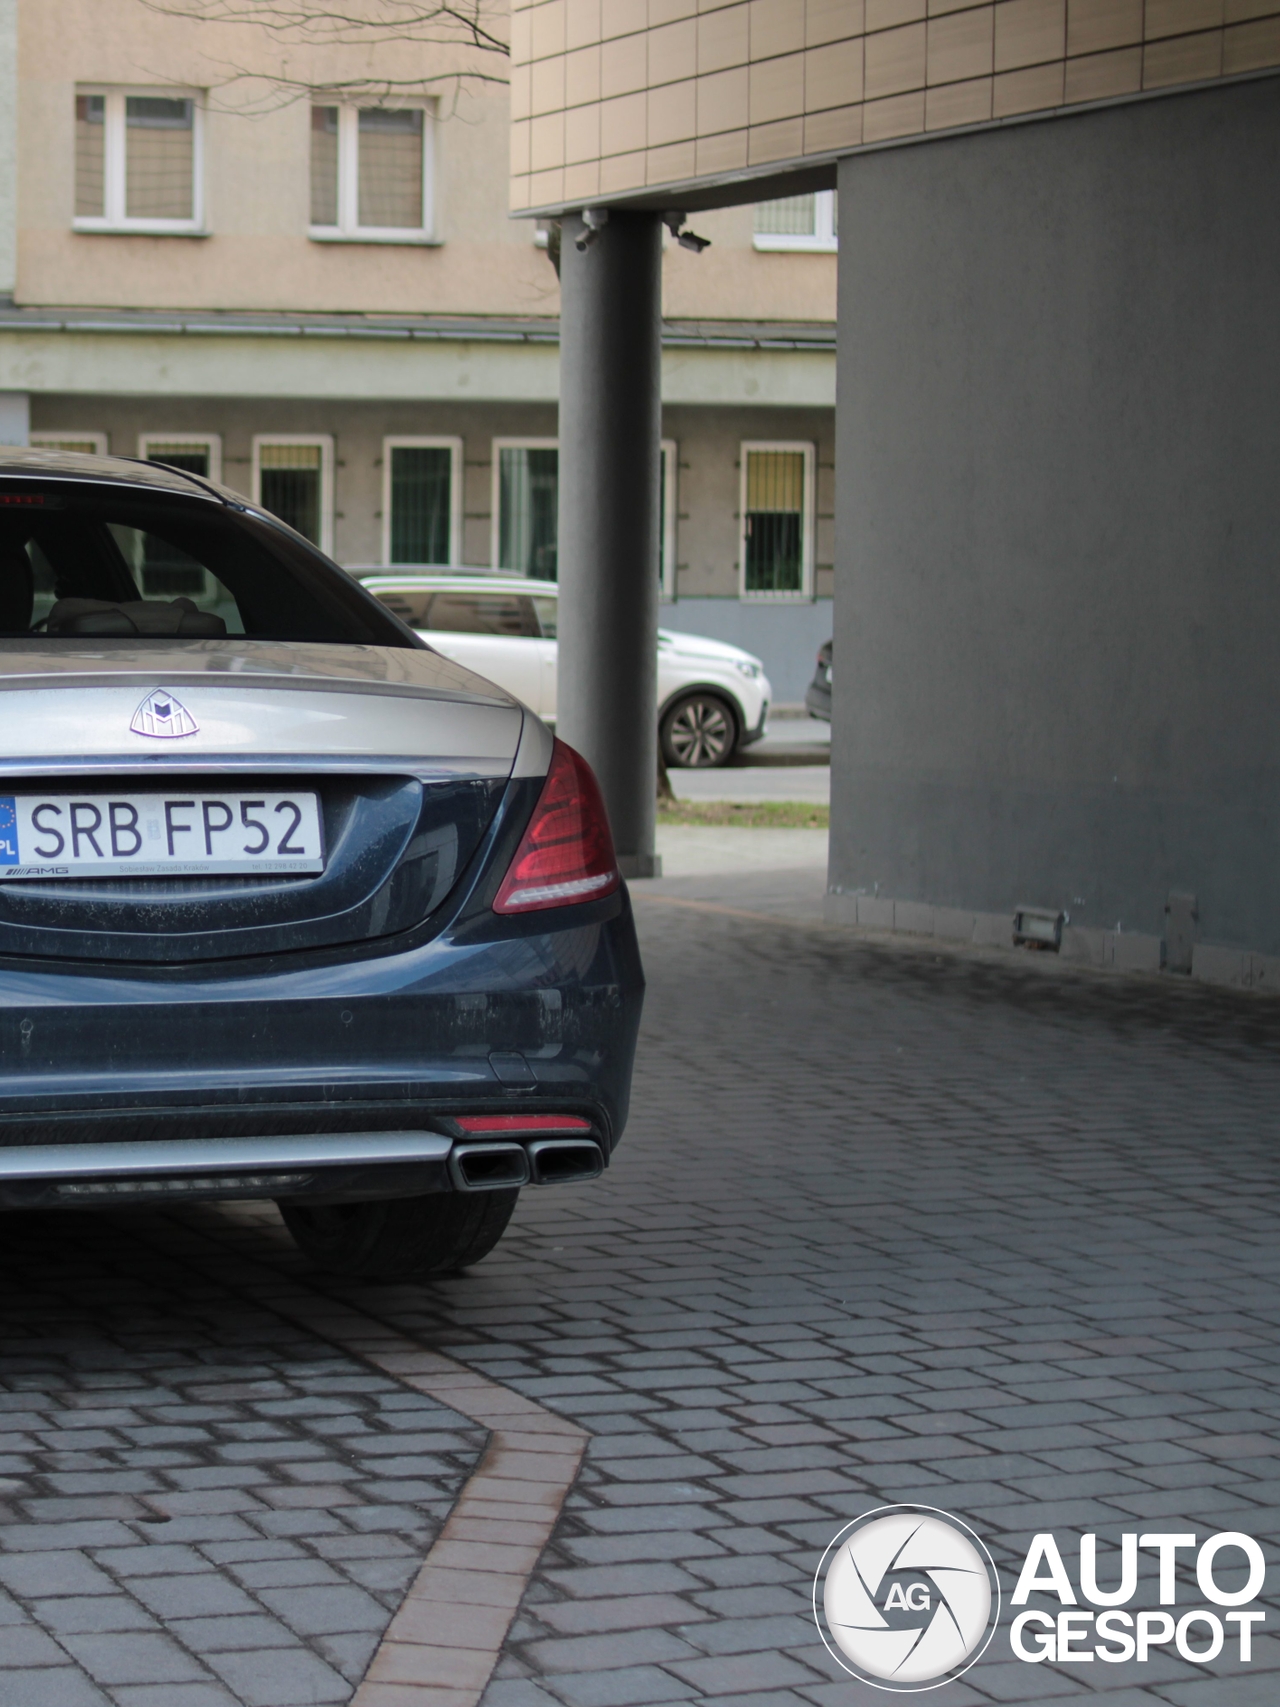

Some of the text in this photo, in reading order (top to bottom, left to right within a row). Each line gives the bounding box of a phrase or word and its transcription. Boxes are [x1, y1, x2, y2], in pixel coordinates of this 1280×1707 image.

[30, 800, 306, 859] SRB FP52
[156, 864, 182, 872] Zasada
[183, 864, 210, 872] Kraków
